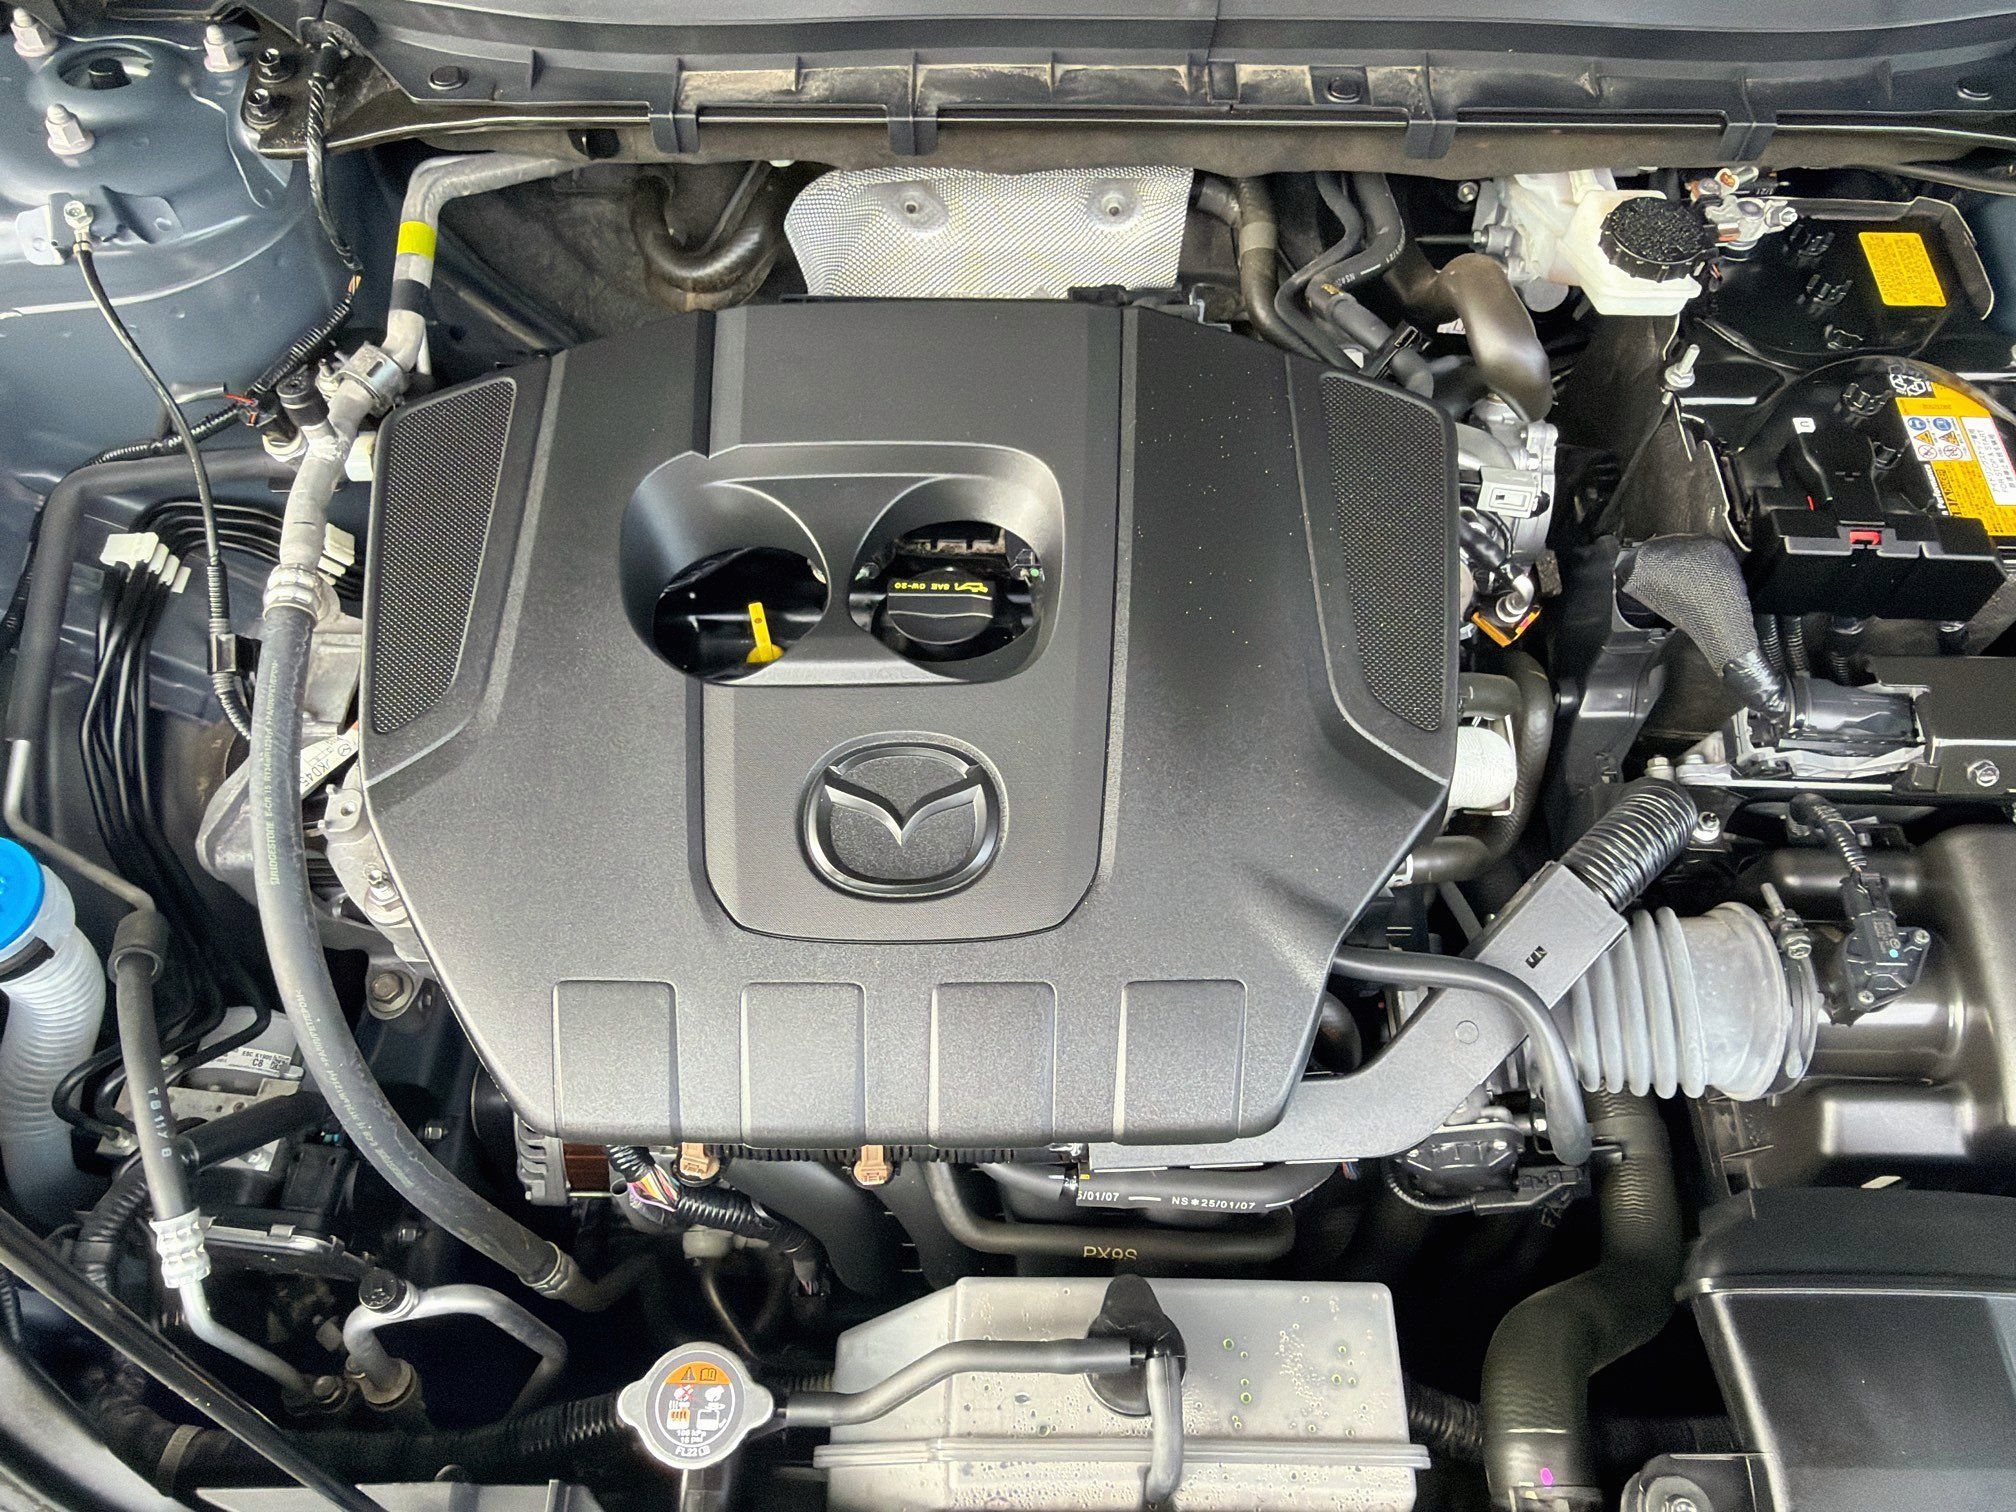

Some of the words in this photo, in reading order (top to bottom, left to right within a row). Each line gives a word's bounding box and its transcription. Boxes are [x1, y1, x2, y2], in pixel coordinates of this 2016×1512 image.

[1977, 430, 1991, 450] START
[1990, 459, 2003, 477] STOP
[1924, 464, 1946, 509] Performance
[1997, 479, 2007, 492] FOR
[894, 582, 926, 590] 0W-20
[931, 583, 950, 591] SAE
[675, 1445, 698, 1457] FL22
